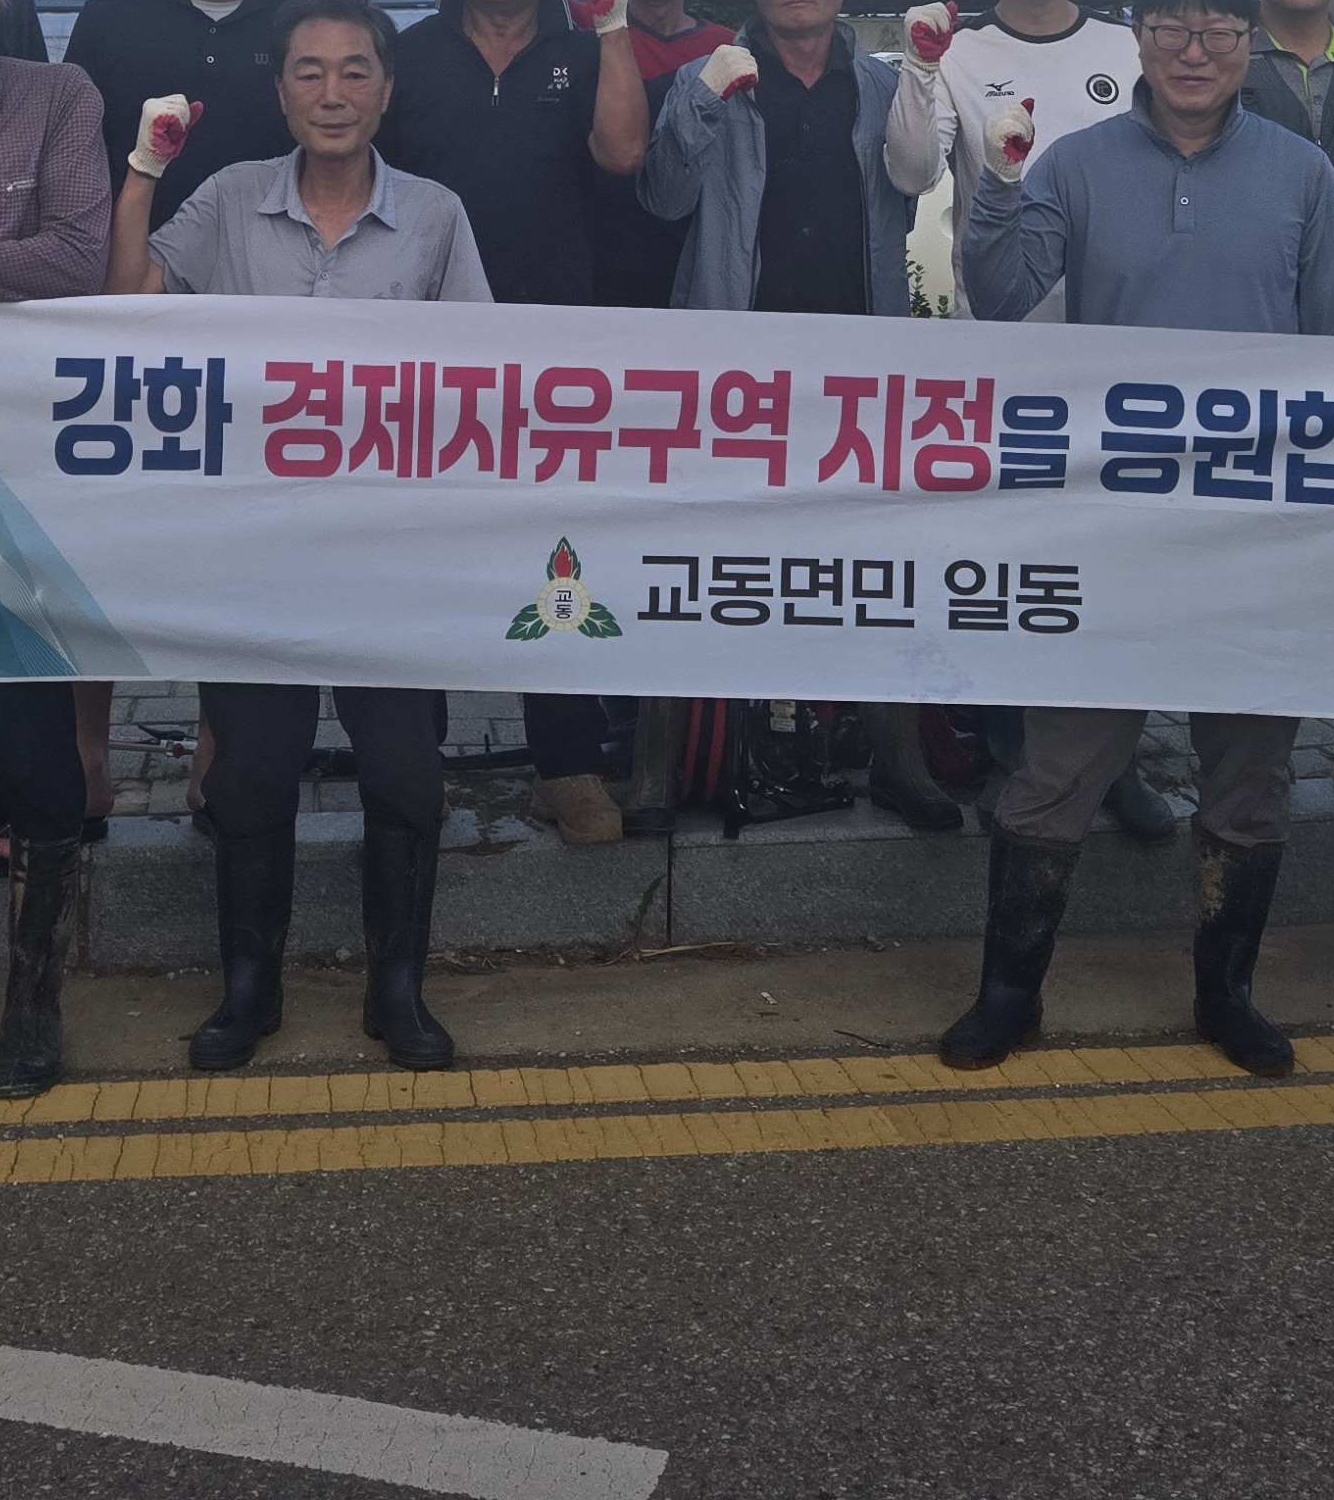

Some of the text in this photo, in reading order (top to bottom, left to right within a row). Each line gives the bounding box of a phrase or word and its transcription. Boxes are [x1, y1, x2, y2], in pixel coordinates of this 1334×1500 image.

[51, 355, 233, 478] 강화
[262, 359, 792, 486] 경제자유구역
[818, 374, 1070, 492] 지정을
[554, 590, 573, 619] 교동
[638, 553, 1083, 634] 교동면민 일동
